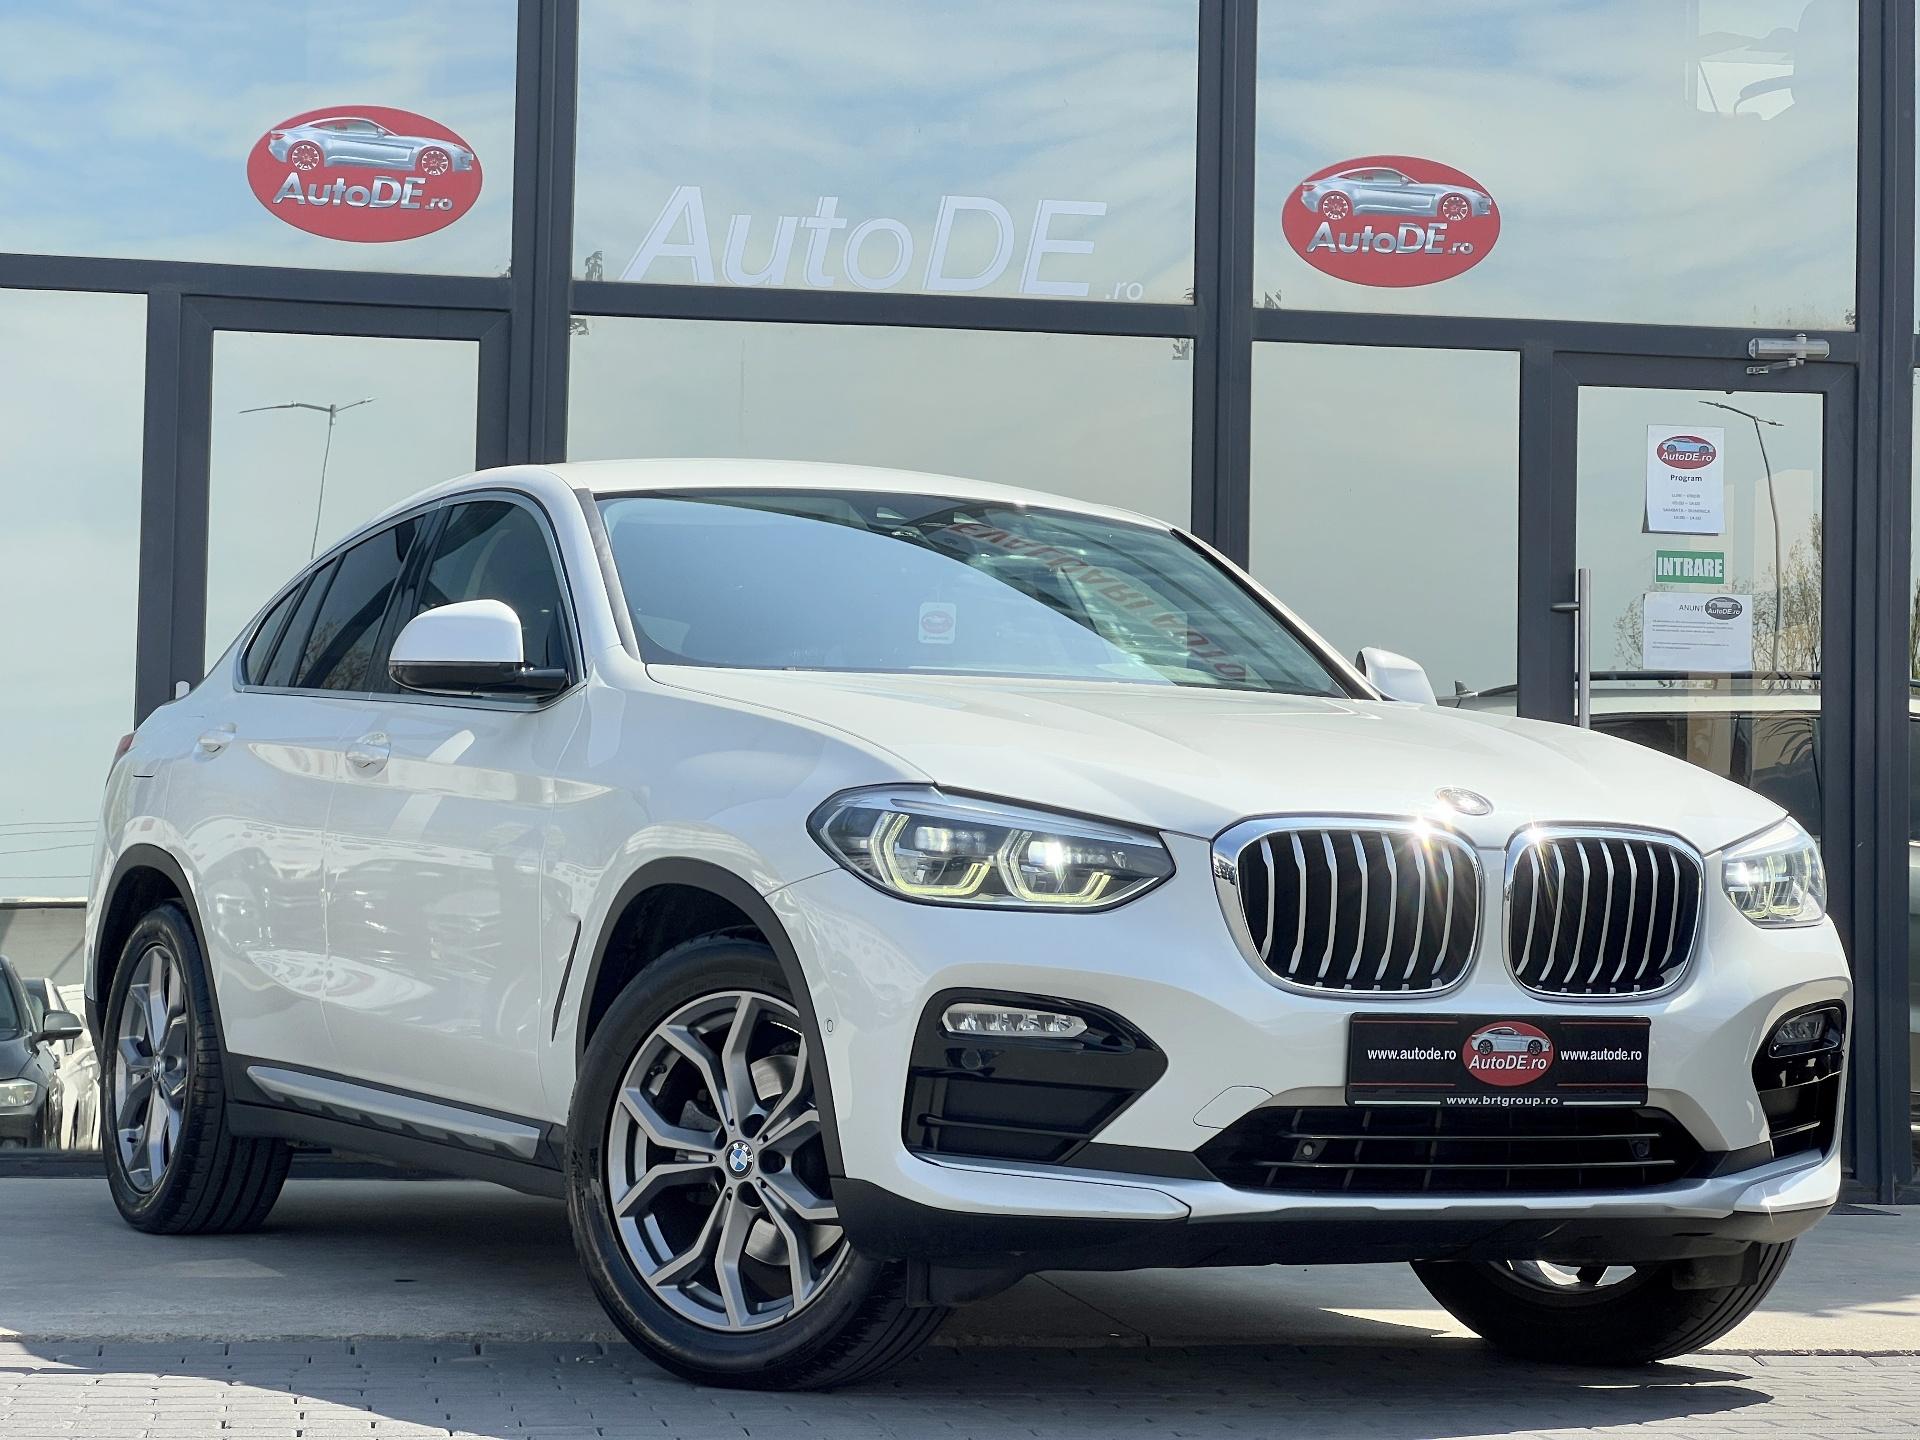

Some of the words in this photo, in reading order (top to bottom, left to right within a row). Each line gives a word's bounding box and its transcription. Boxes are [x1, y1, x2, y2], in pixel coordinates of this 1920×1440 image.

[272, 171, 453, 211] AutoDE.ro
[1306, 221, 1474, 255] AutoDE.ro
[1661, 452, 1712, 462] AutoDE.ro
[1670, 474, 1702, 482] Program
[1657, 557, 1723, 578] INTRARE
[1367, 1047, 1457, 1060] www.autode.ro
[1560, 1047, 1642, 1061] www.autode.ro
[1468, 1054, 1547, 1071] AutoDE.ro
[1446, 1095, 1559, 1107] www.brtgroup.ro
